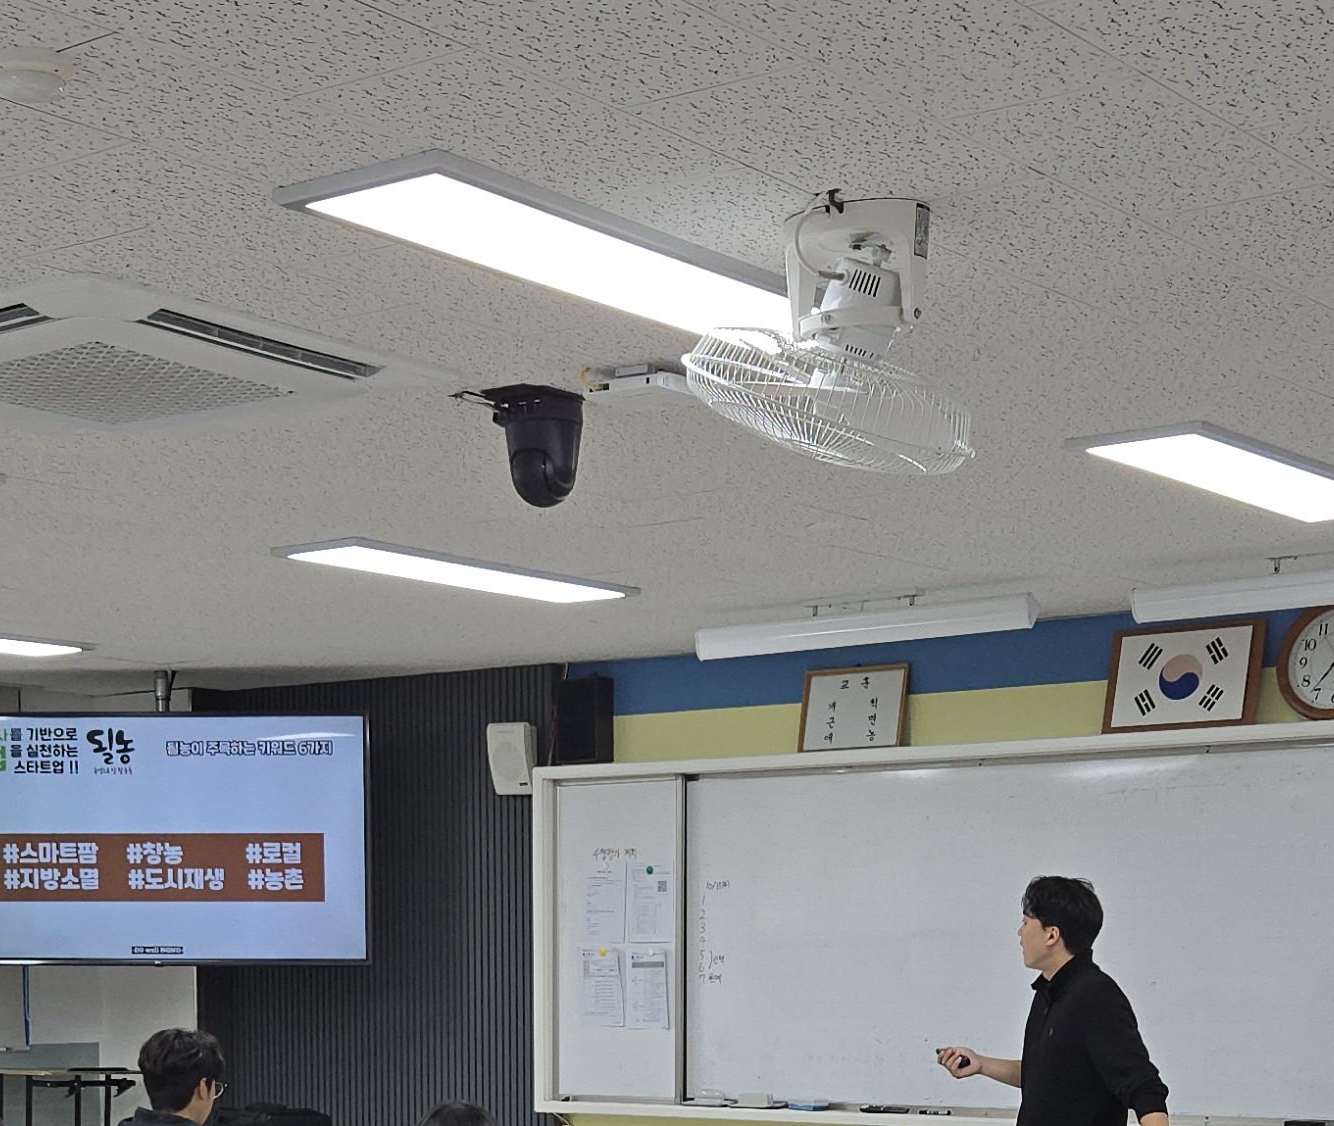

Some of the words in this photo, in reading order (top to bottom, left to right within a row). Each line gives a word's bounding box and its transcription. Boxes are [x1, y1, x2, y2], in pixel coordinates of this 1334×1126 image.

[1319, 623, 1328, 636] 11
[1301, 639, 1317, 651] 10
[1299, 657, 1308, 669] 9
[1301, 674, 1311, 687] 8
[1313, 687, 1322, 700] 7
[26, 728, 78, 741] 기반으로
[26, 744, 79, 758] 실천하는
[258, 740, 297, 755] 키워드
[298, 740, 334, 755] 6가지
[13, 760, 65, 774] 스타트업
[69, 760, 79, 774] !!
[3, 842, 99, 864] #스마트팜
[126, 842, 184, 864] #창농
[245, 842, 302, 864] #로컬
[4, 868, 99, 890] #지방소멸
[128, 868, 225, 890] #도시재생
[247, 868, 304, 890] #농촌
[701, 894, 706, 905] 1
[699, 908, 707, 920] 2
[699, 922, 706, 934] 3
[699, 949, 706, 960] 5
[698, 962, 705, 973] 6
[699, 974, 706, 984] 7
